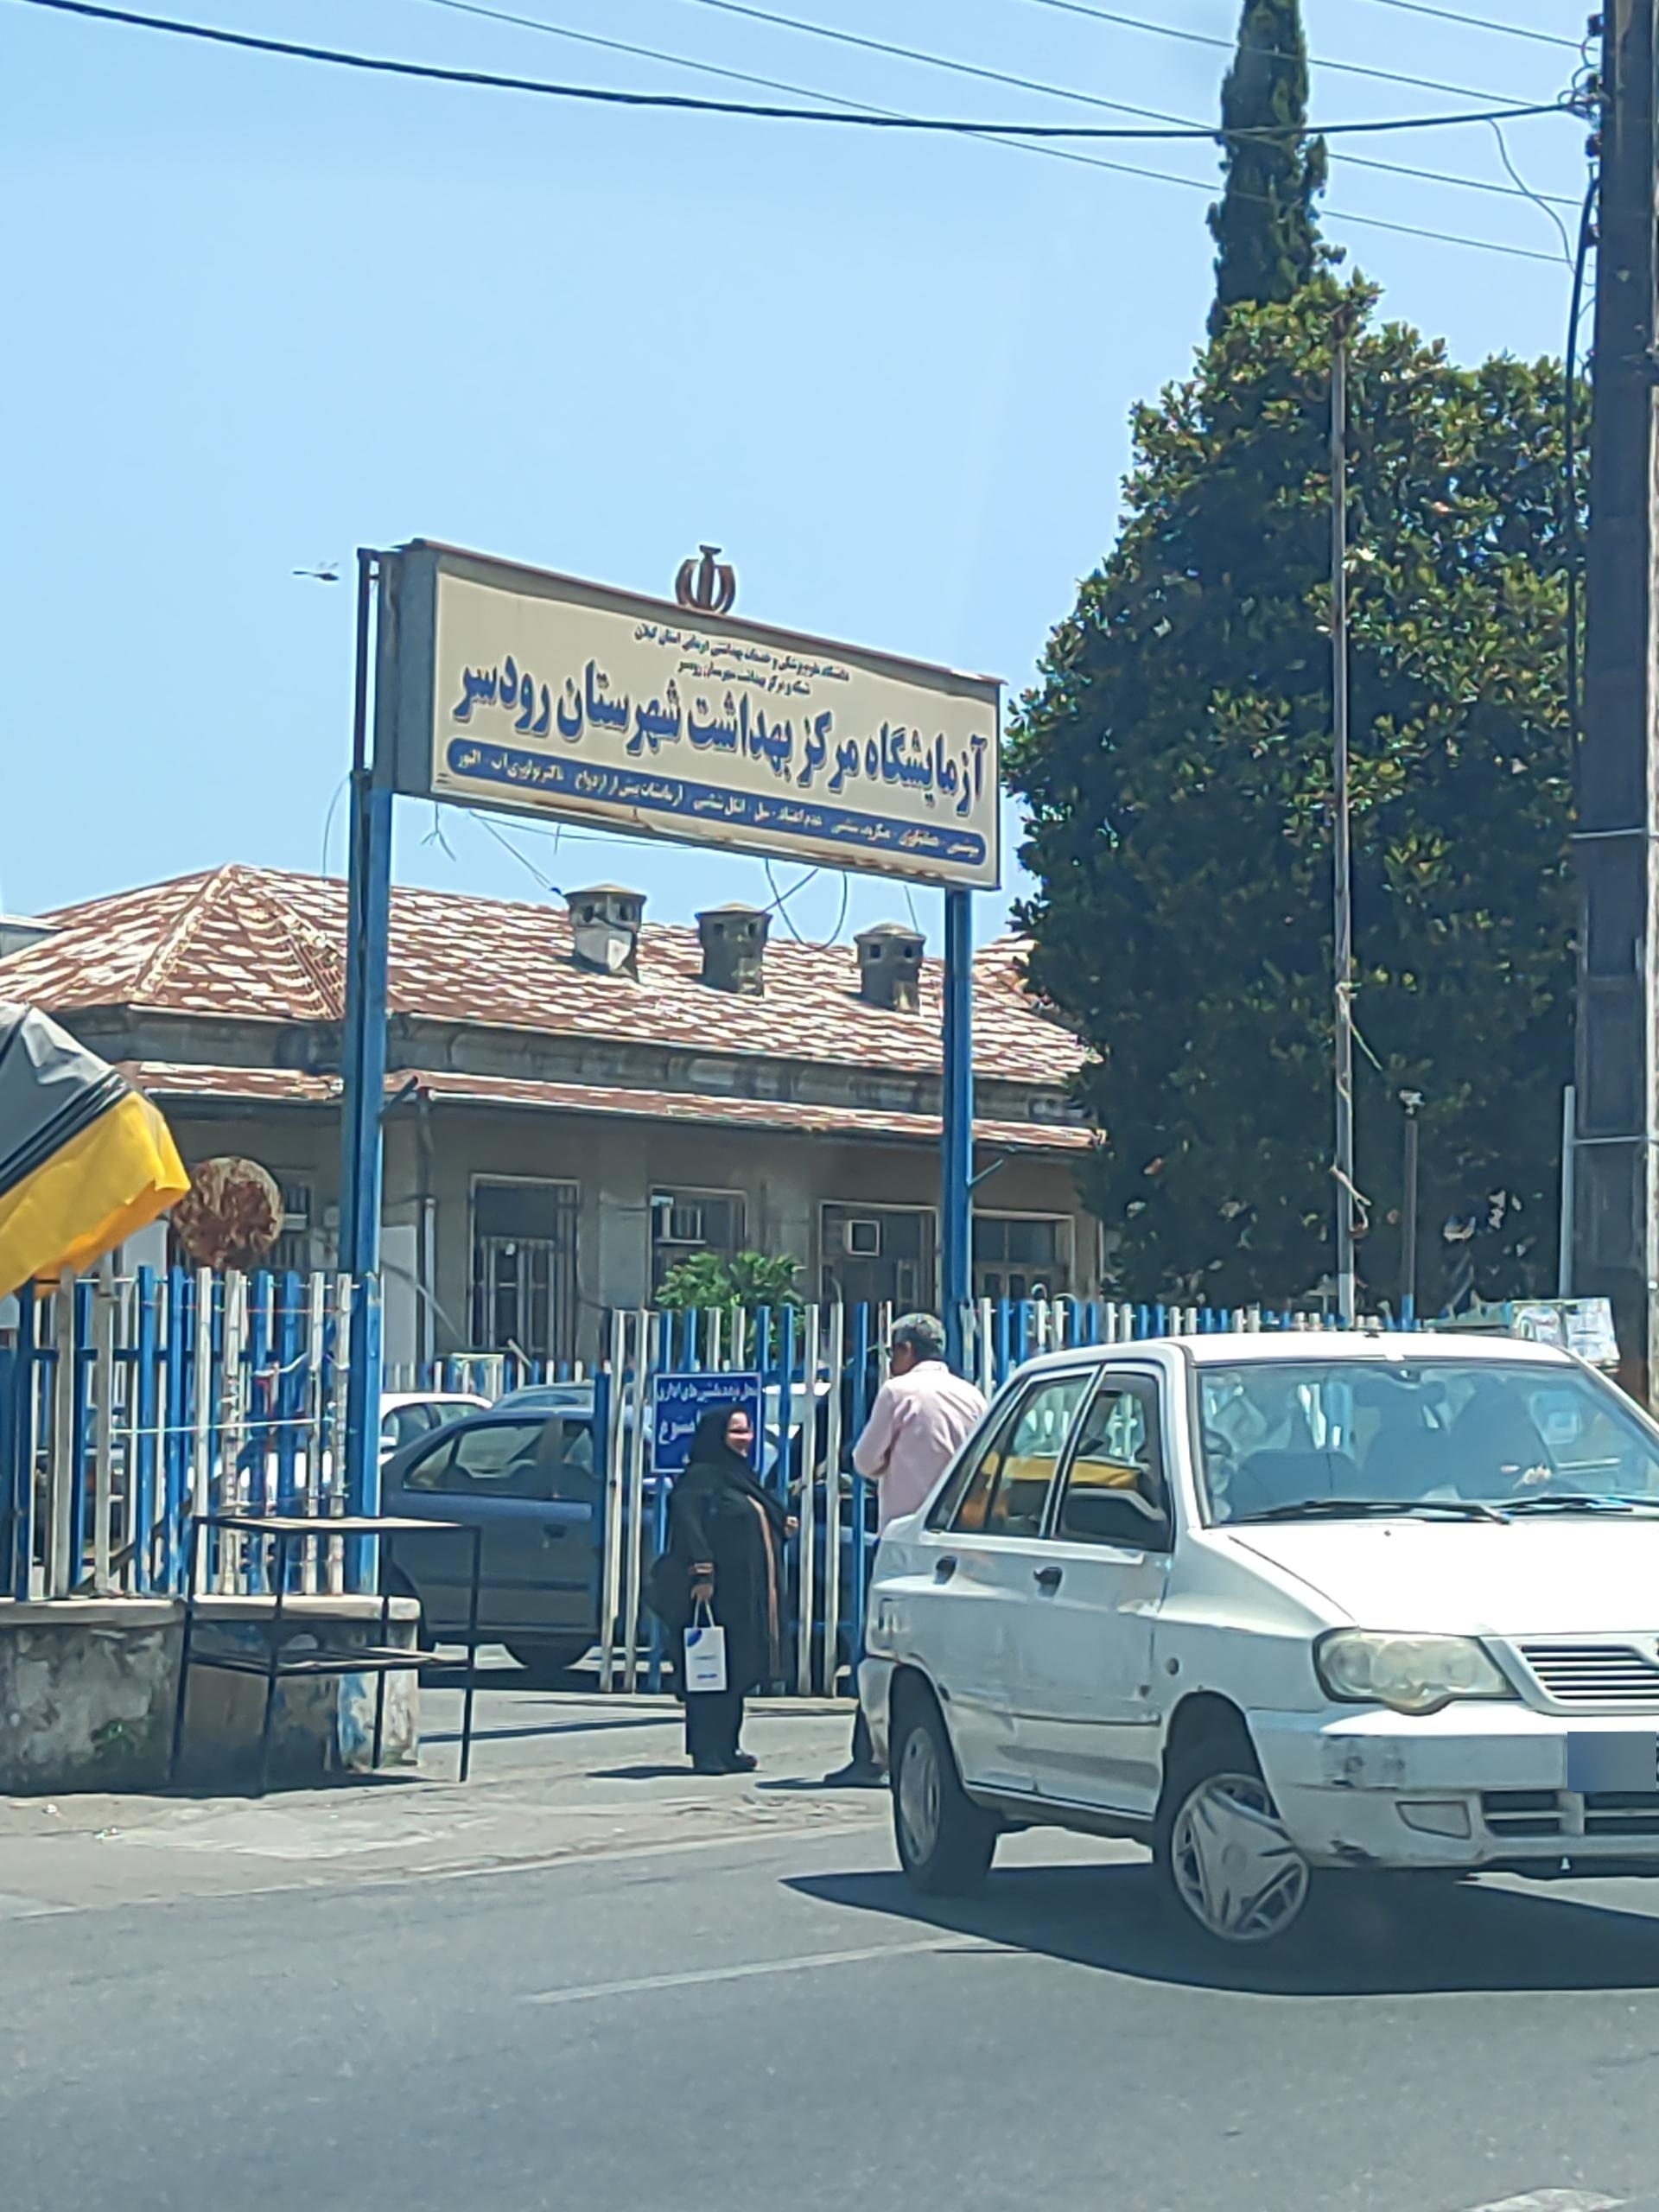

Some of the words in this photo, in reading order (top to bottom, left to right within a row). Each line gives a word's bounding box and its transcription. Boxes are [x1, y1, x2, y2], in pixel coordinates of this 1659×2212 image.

[453, 655, 551, 738] رودسر
[556, 659, 681, 757] شهرستان
[688, 690, 792, 782] بهداشت
[797, 710, 859, 794] مرکز
[865, 721, 988, 817] آزمایشگاه
